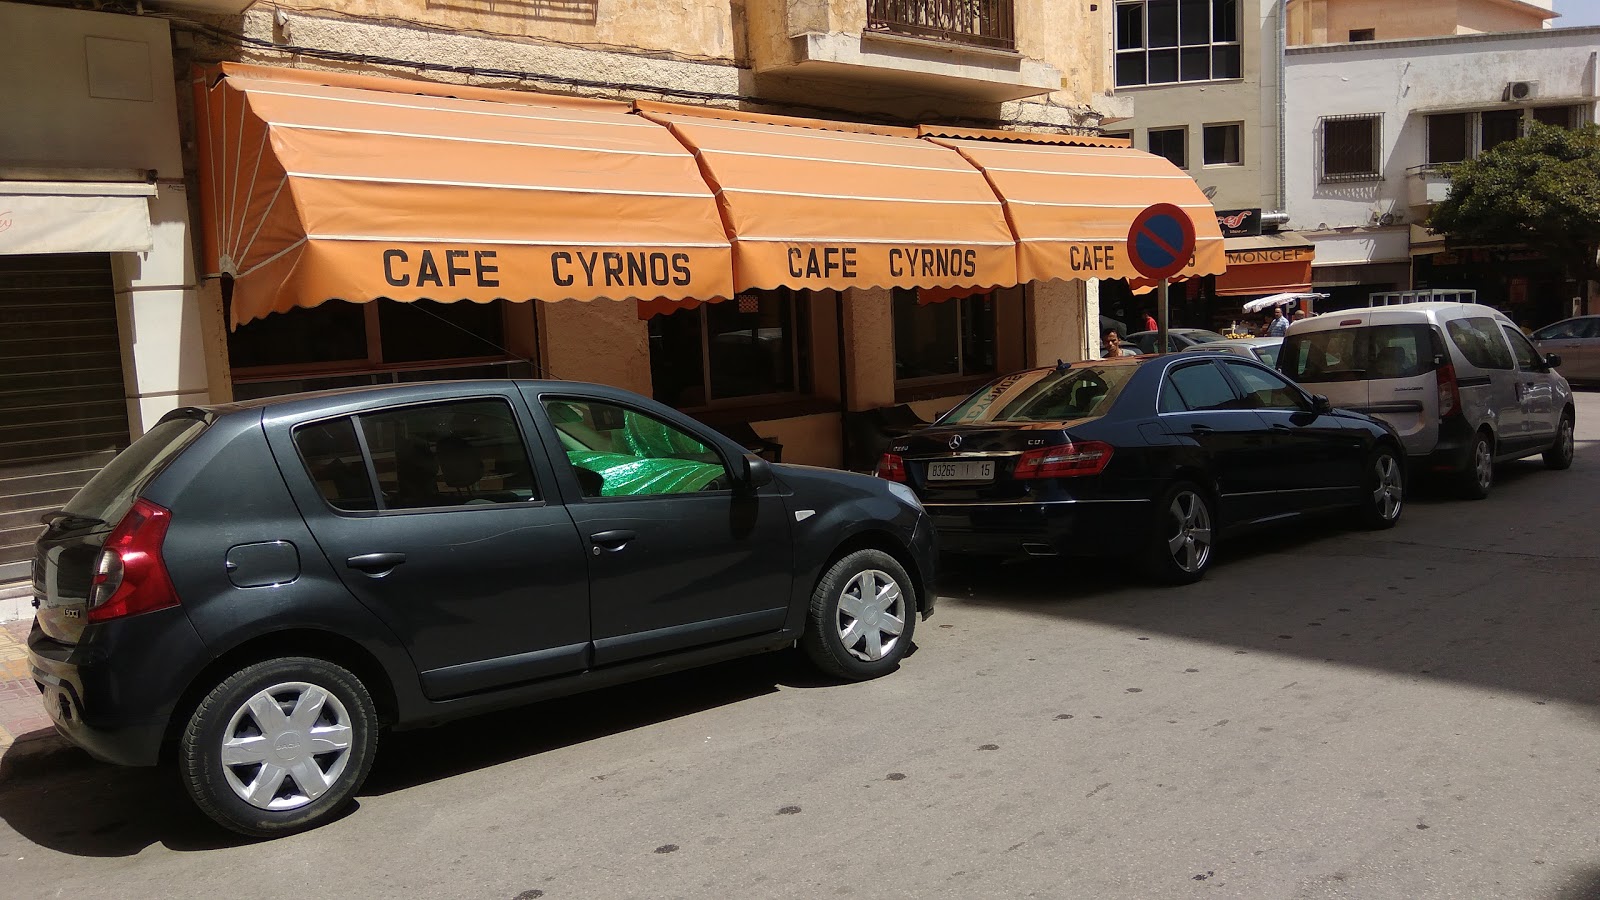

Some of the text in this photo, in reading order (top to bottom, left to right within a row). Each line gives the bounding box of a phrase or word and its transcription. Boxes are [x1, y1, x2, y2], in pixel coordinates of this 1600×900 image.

[382, 248, 691, 288] CAFE CYRNOS
[787, 247, 977, 279] CAFE CYRNOS
[1069, 245, 1115, 271] CAFE
[1227, 249, 1304, 264] MONCEF
[981, 463, 990, 476] 15
